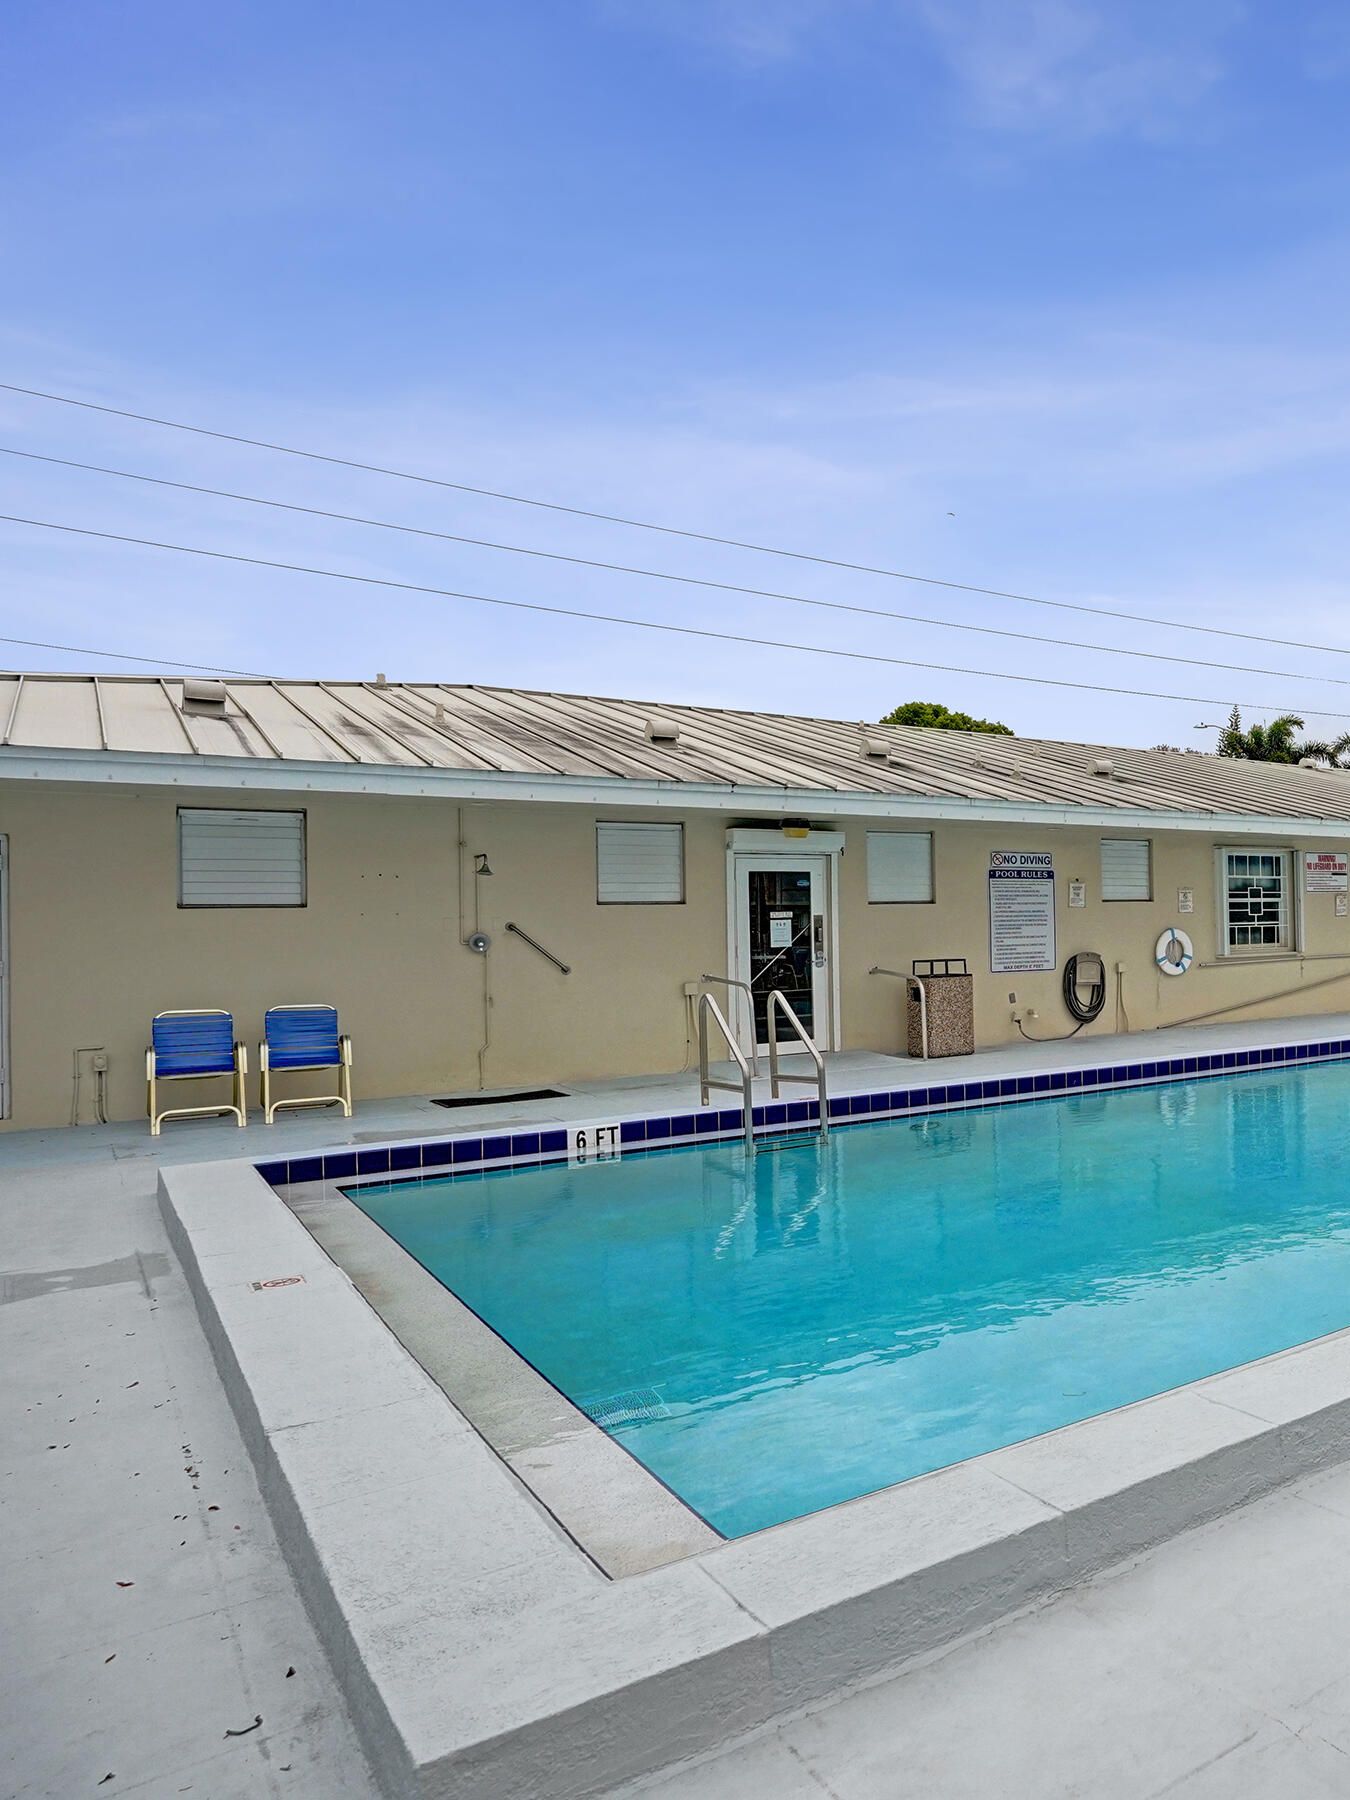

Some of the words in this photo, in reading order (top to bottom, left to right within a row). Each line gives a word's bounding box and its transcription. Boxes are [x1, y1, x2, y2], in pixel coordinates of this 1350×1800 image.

[1003, 855, 1018, 865] NO
[1020, 855, 1051, 866] DIVING
[995, 870, 1020, 878] POOL
[1021, 871, 1049, 879] RULES
[576, 1130, 587, 1149] 6
[596, 1126, 619, 1147] FT
